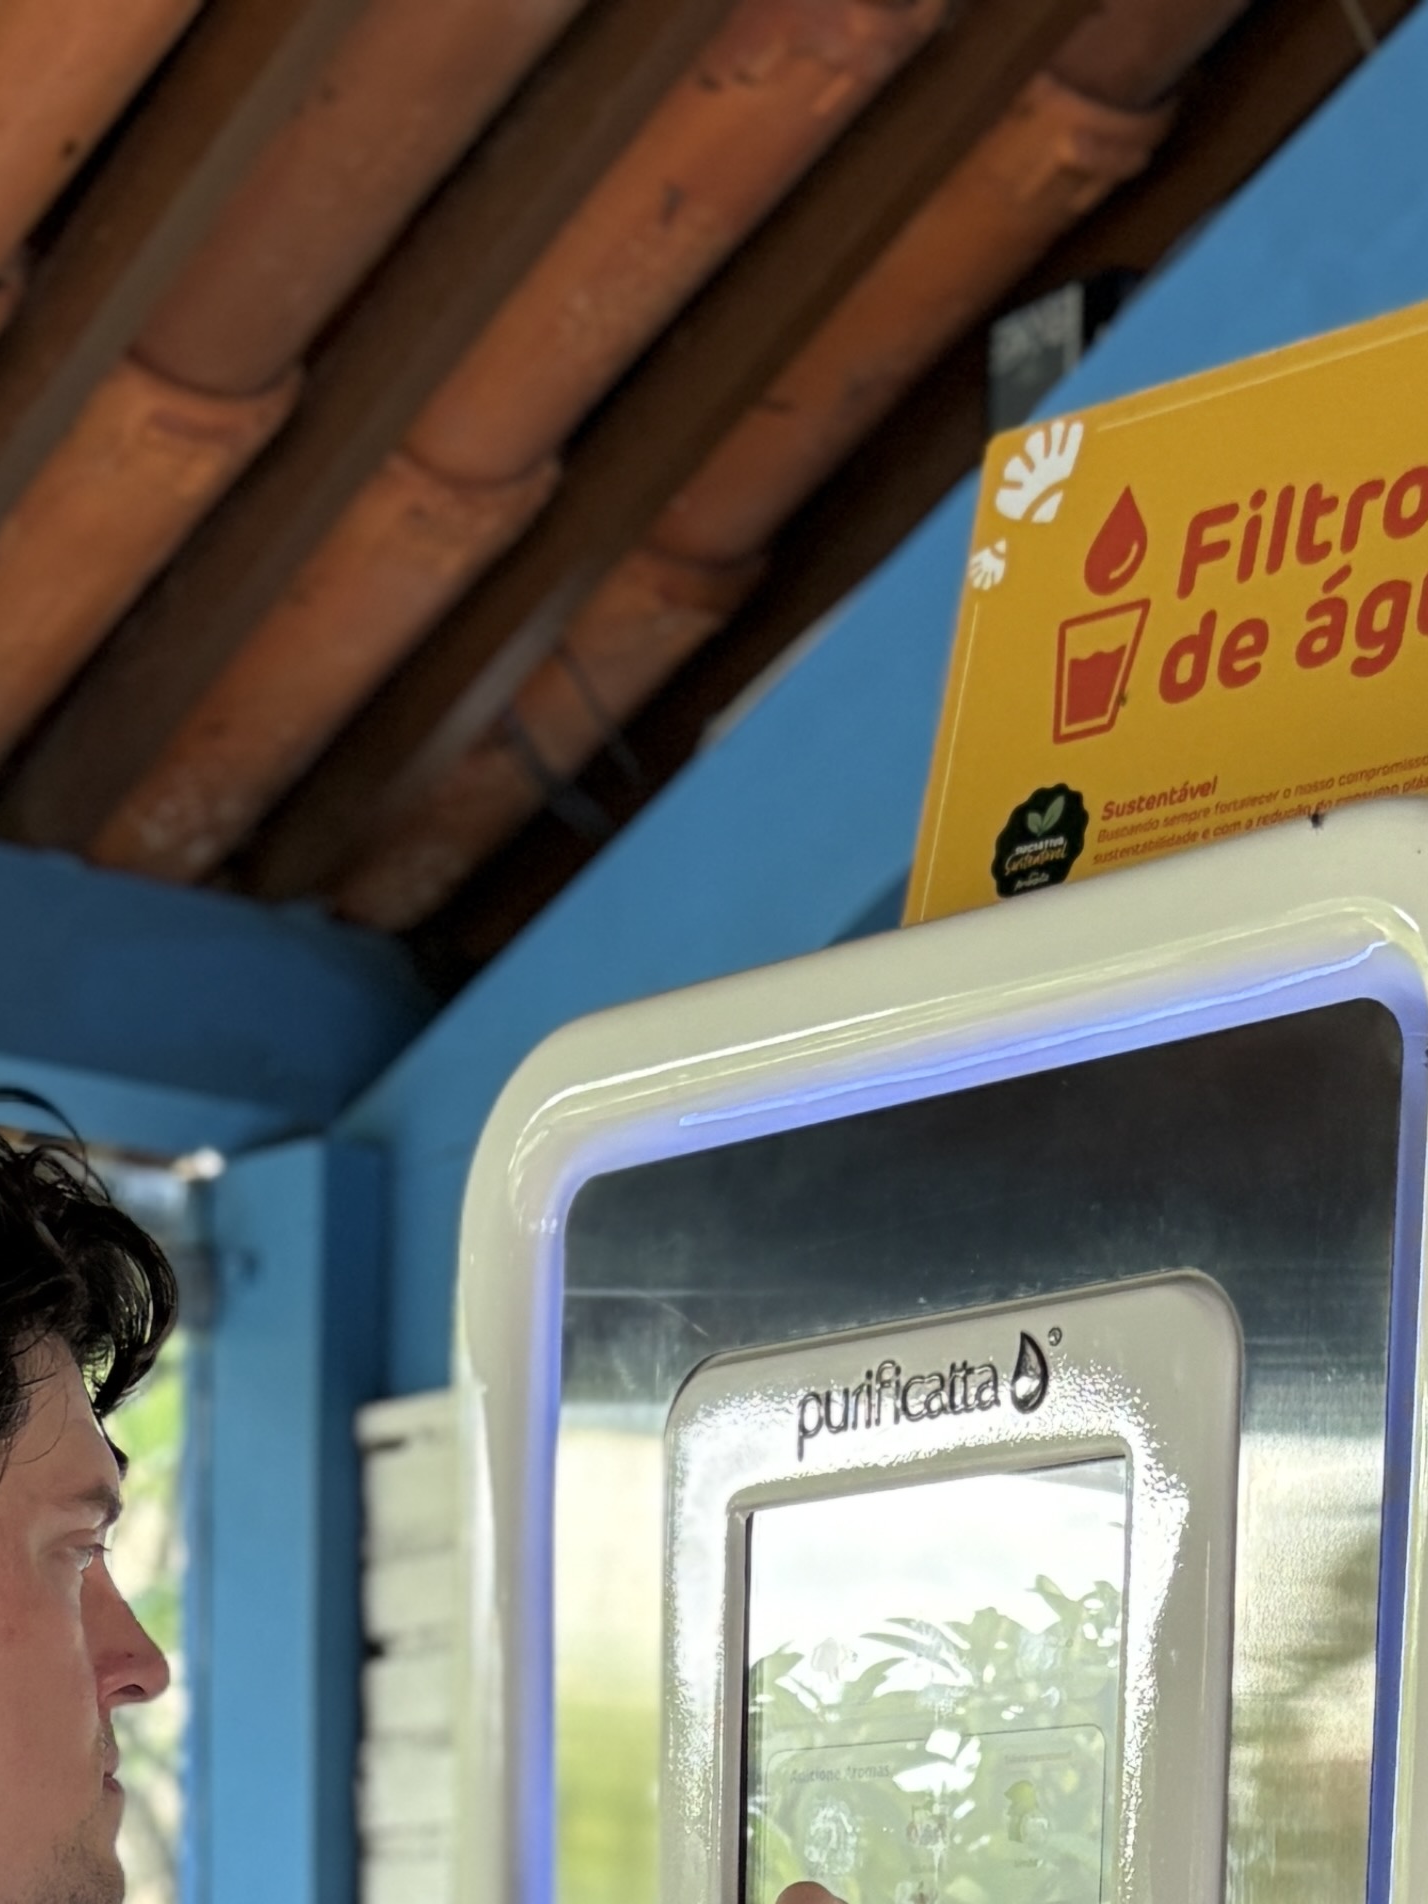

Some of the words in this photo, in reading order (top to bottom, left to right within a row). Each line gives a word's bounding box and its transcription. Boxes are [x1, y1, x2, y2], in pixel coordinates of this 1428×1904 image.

[1159, 609, 1269, 704] de
[1101, 774, 1218, 821] Sustentável
[1294, 776, 1334, 797] nosso
[797, 1359, 1002, 1462] purificatta
